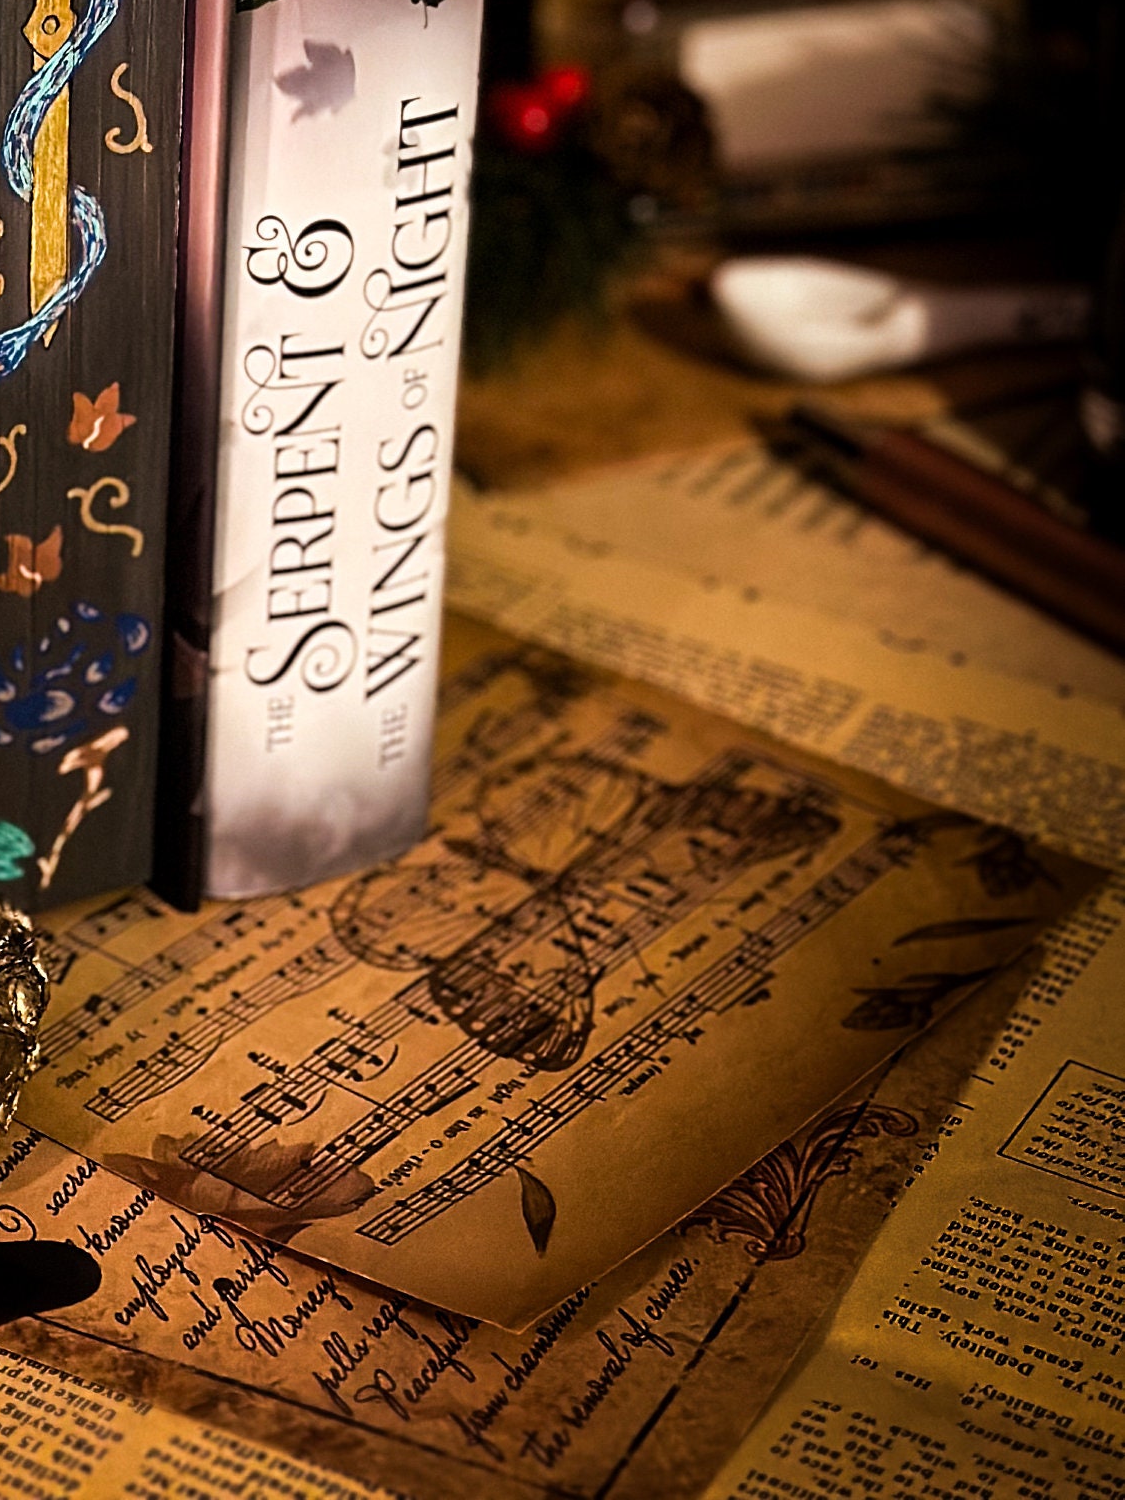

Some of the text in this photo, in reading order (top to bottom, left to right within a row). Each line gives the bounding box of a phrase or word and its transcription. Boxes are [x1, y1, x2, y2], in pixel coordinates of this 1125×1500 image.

[361, 96, 460, 771] THE WINGS OF NIGHT
[241, 214, 358, 754] THE SERPENT &
[183, 1292, 223, 1350] and
[236, 1274, 353, 1357] Money
[962, 1320, 1009, 1347] work
[993, 1298, 1040, 1323] work
[21, 1375, 52, 1393] the
